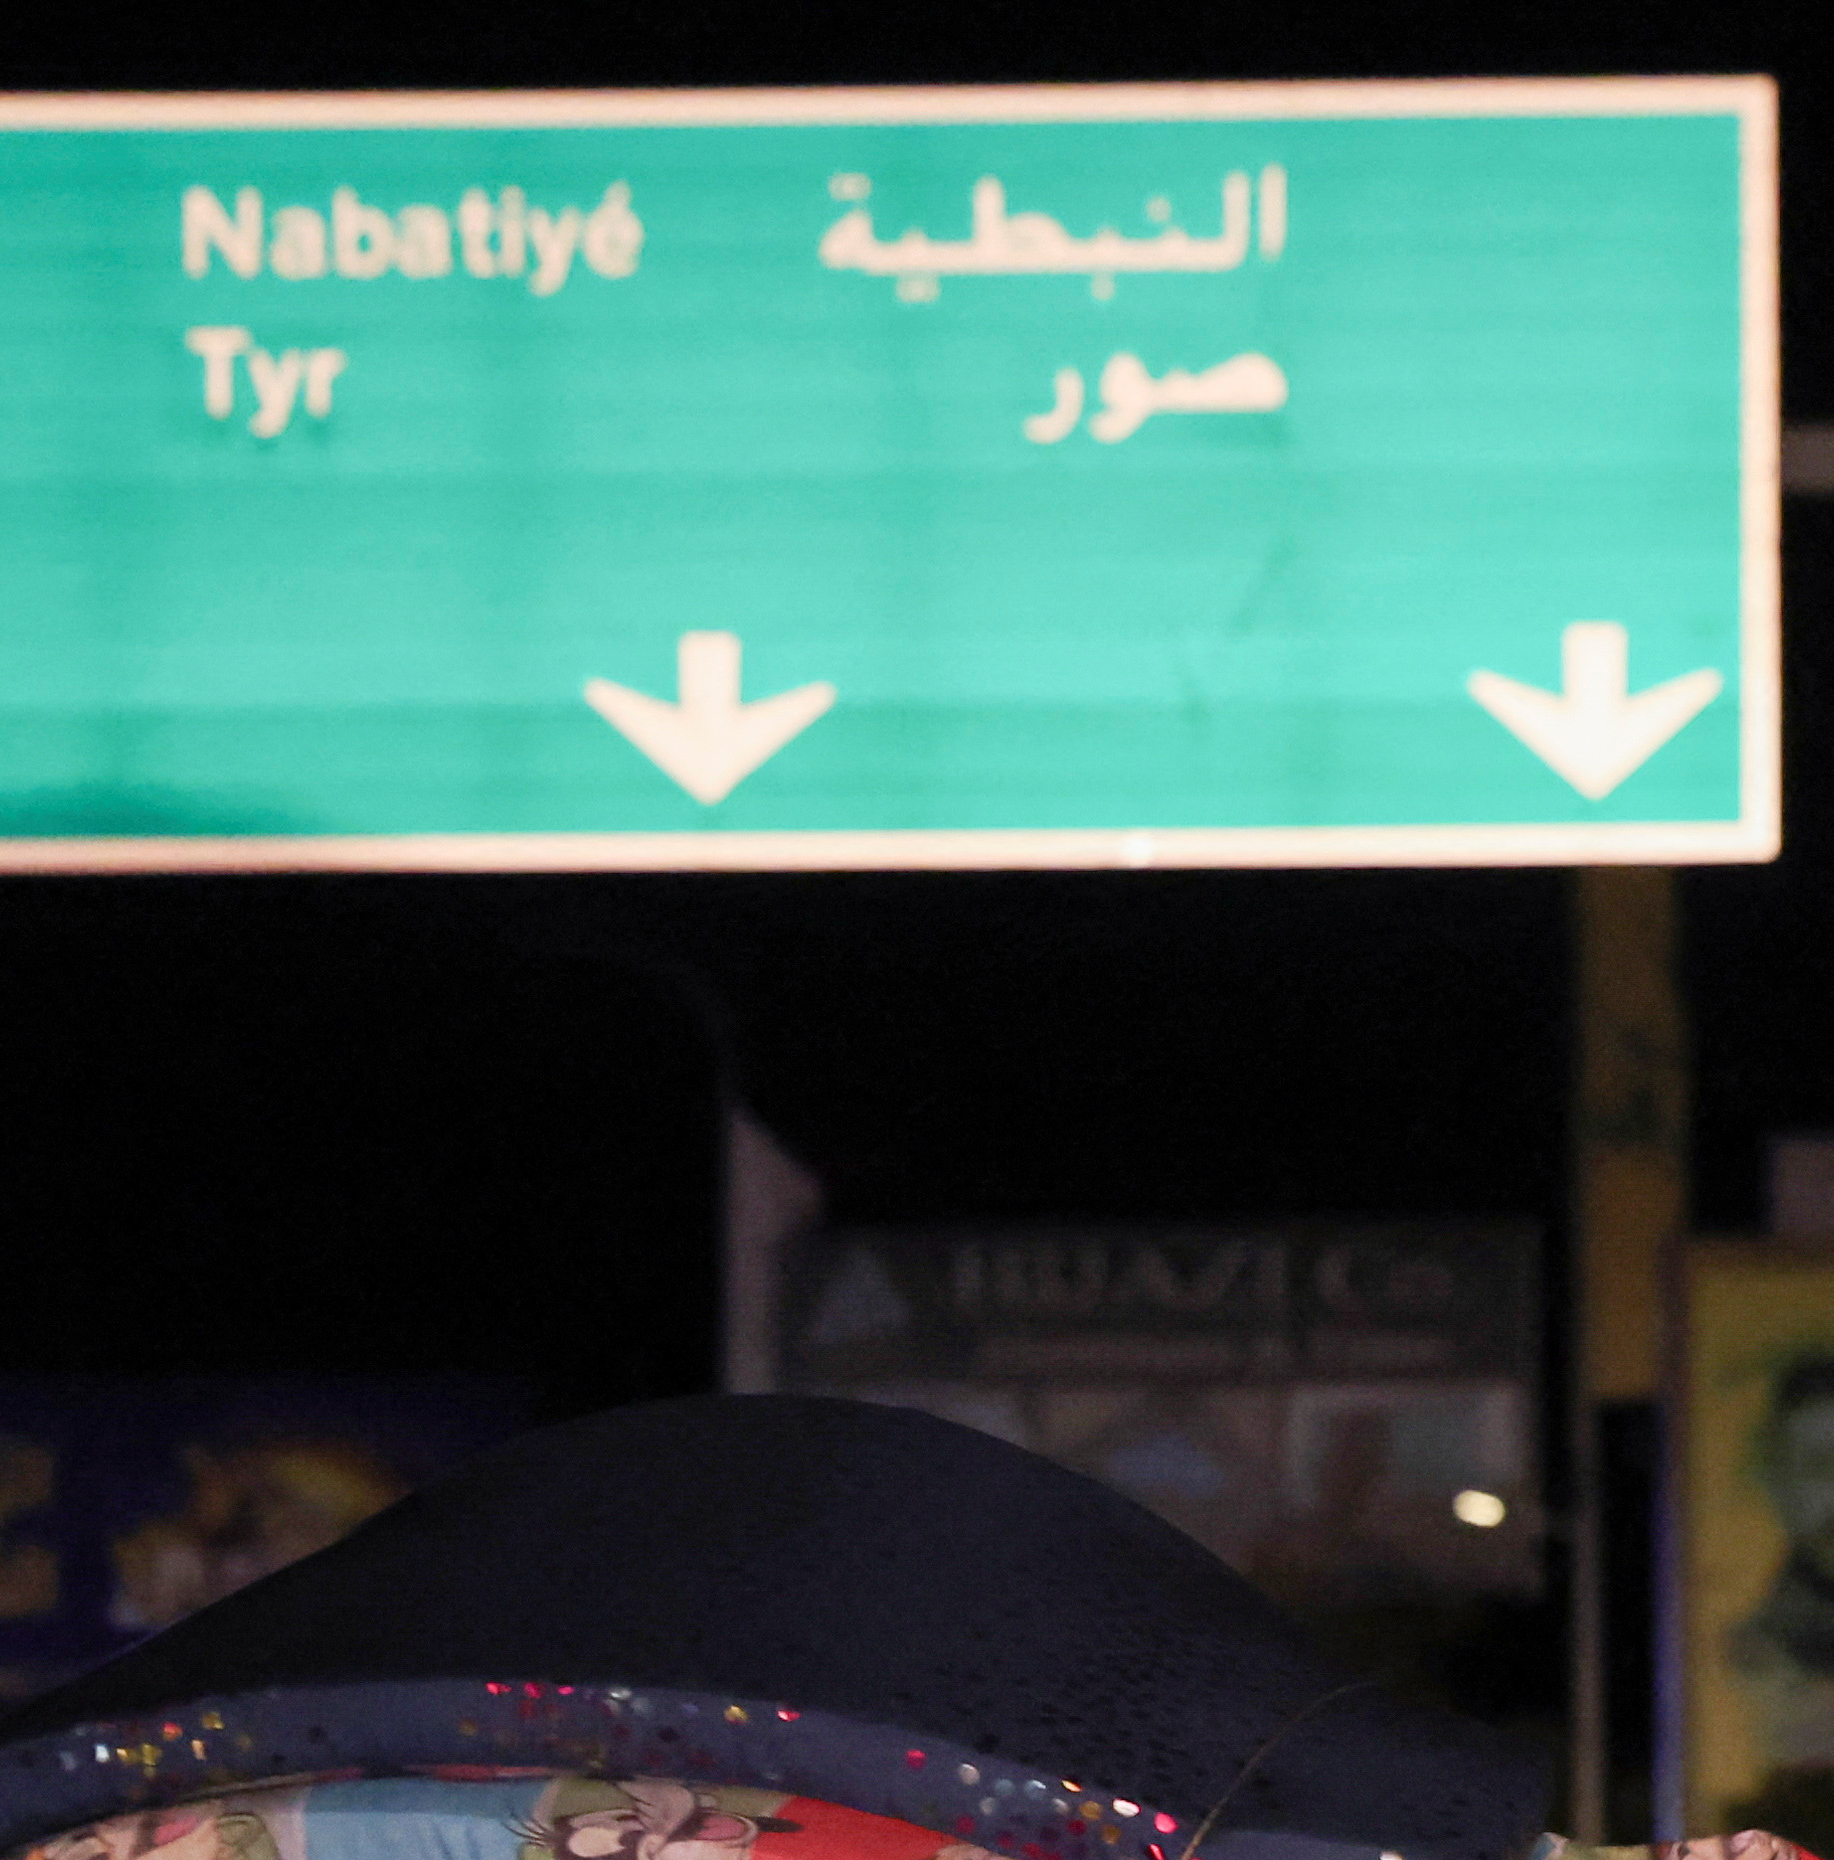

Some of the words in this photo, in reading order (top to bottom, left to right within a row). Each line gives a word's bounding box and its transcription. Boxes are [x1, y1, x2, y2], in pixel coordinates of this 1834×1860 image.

[182, 181, 645, 297] Nabatiyé
[818, 164, 1288, 303] النبطية
[185, 325, 348, 439] Tyr
[1024, 353, 1289, 445] صور
